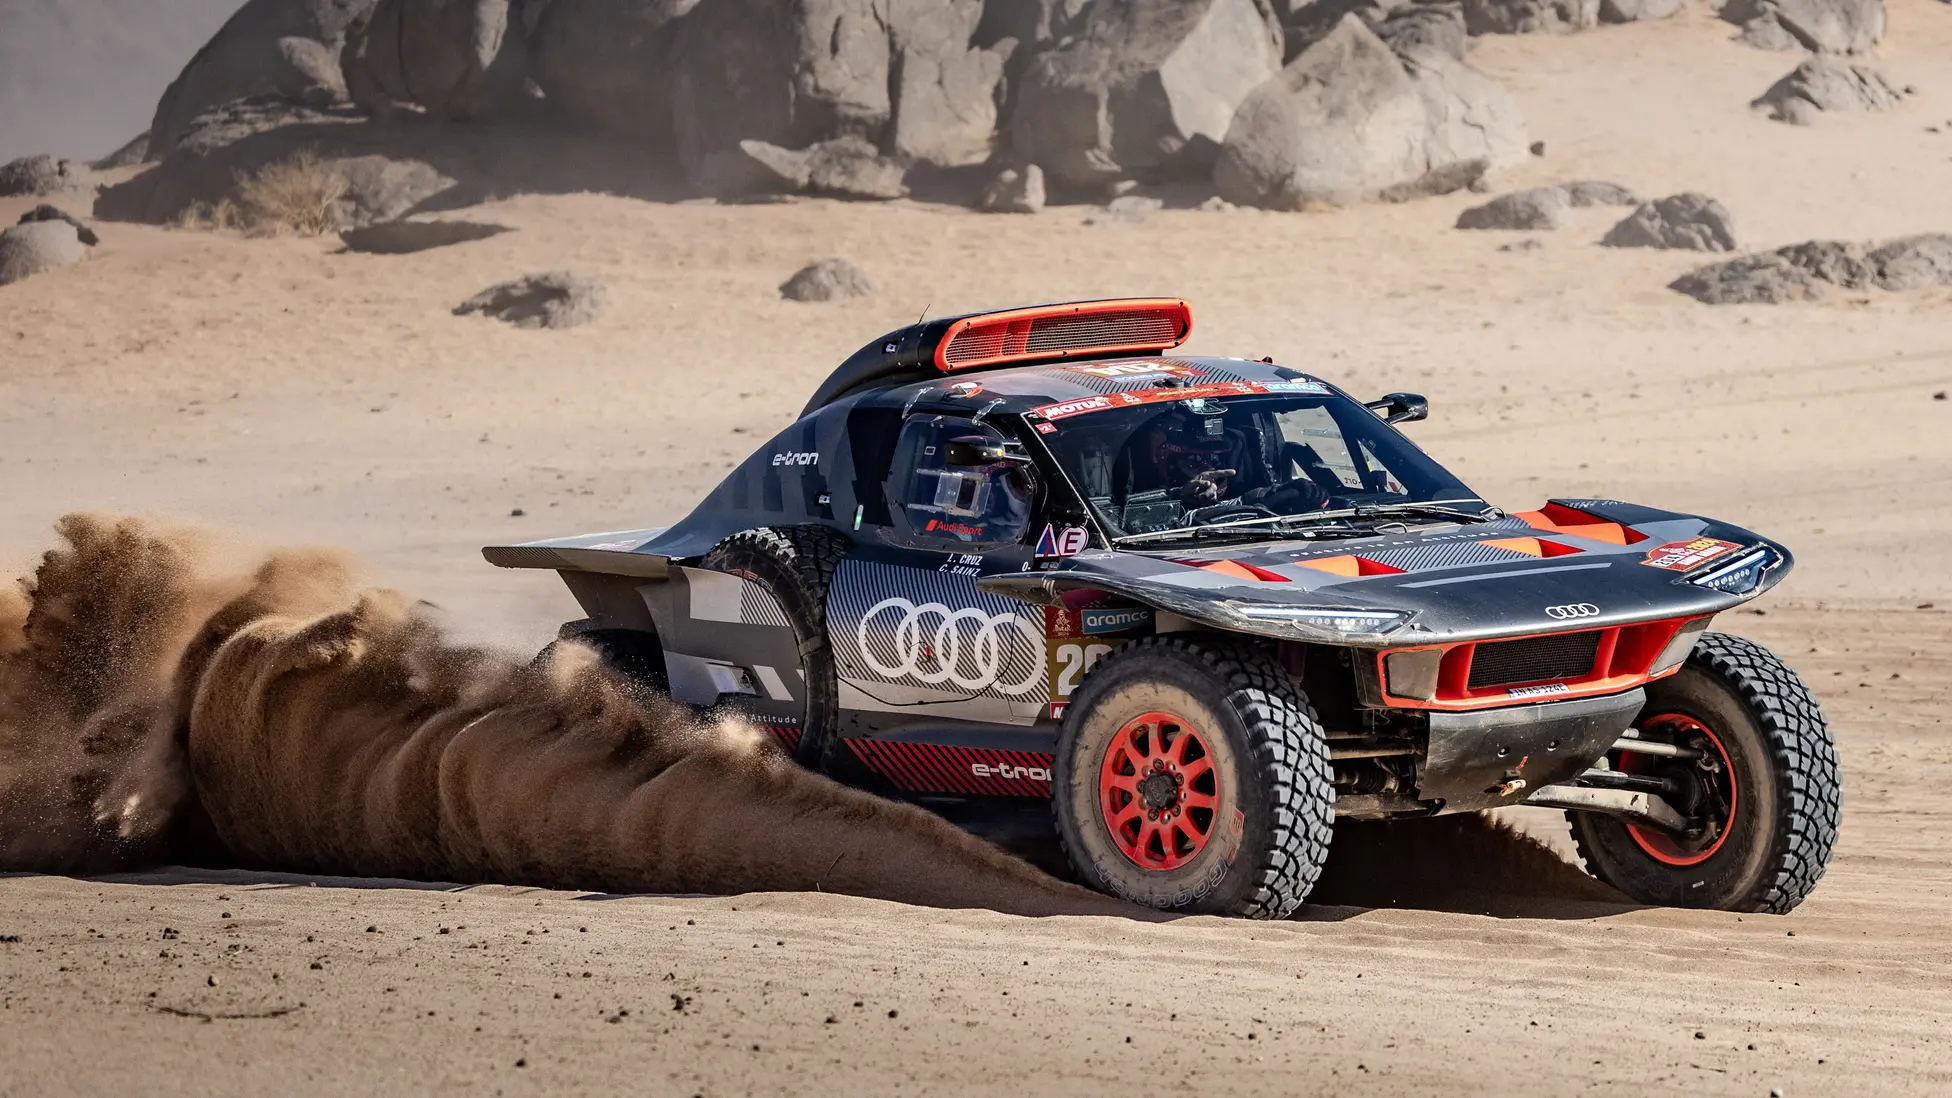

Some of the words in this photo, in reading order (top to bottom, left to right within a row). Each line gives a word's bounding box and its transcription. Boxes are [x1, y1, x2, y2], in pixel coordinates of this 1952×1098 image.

[772, 450, 819, 466] e-tron
[937, 521, 957, 533] Audi
[958, 523, 983, 536] Sport
[1064, 532, 1081, 553] E
[947, 553, 957, 563] L.
[959, 554, 983, 566] CRUZ
[939, 563, 949, 573] C.
[950, 565, 981, 577] SAINZ
[751, 713, 797, 724] Attitude
